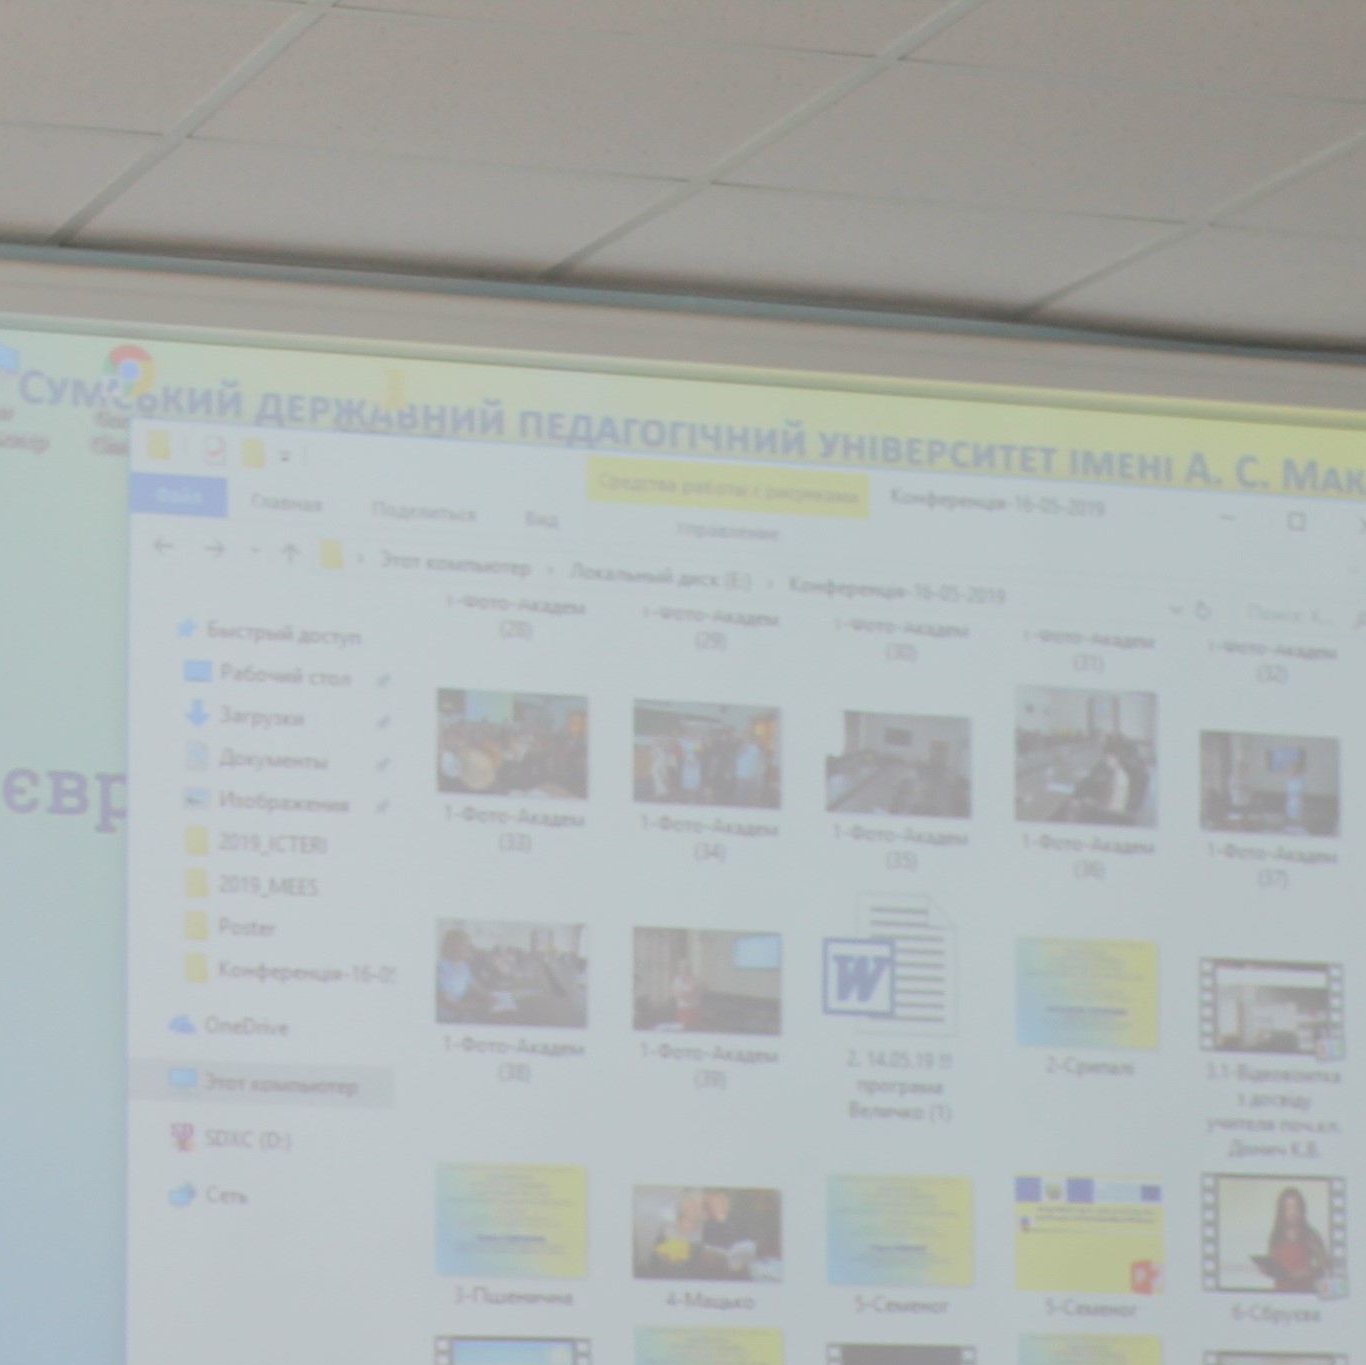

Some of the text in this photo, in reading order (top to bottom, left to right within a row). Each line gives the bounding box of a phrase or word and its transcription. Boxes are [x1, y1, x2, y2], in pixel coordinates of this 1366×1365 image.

[253, 390, 505, 438] ДЕРЖАВНИЙ
[519, 409, 808, 459] ПЕДАГОГІЧНИЙ
[818, 431, 1058, 475] УНІВЕРСИТЕТ
[1069, 449, 1174, 483] ІМЕНІ
[1185, 452, 1224, 485] А.
[1235, 455, 1270, 488] С.
[250, 492, 323, 514] Главная
[371, 500, 477, 526] Поделиться
[525, 510, 560, 531] Вид
[380, 548, 421, 570] Этот
[425, 555, 533, 581] компьютер
[570, 560, 674, 587] Локальный
[677, 570, 720, 590] диск
[206, 618, 363, 650] Быстрый доступ
[220, 661, 353, 688] Рабочий стол
[218, 705, 306, 729] Загрузки
[218, 748, 329, 773] Документы
[218, 791, 351, 816] Изображения
[443, 804, 586, 829] 1-Фото-Академ
[640, 813, 779, 838] 1-Фото-Академ
[217, 832, 329, 857] 2019_ICTERI
[833, 822, 970, 846] 1-Фото-Академ
[1021, 831, 1156, 856] 1-Фото-Академ
[1206, 841, 1340, 865] 1-Фото-Академ
[217, 874, 321, 899] 2019_MEES
[217, 916, 277, 938] Poster
[204, 1014, 290, 1037] OneDrive
[442, 1034, 586, 1059] 1-Фото-Академ
[639, 1041, 779, 1066] 1-Фото-Академ
[205, 1072, 246, 1091] Этот
